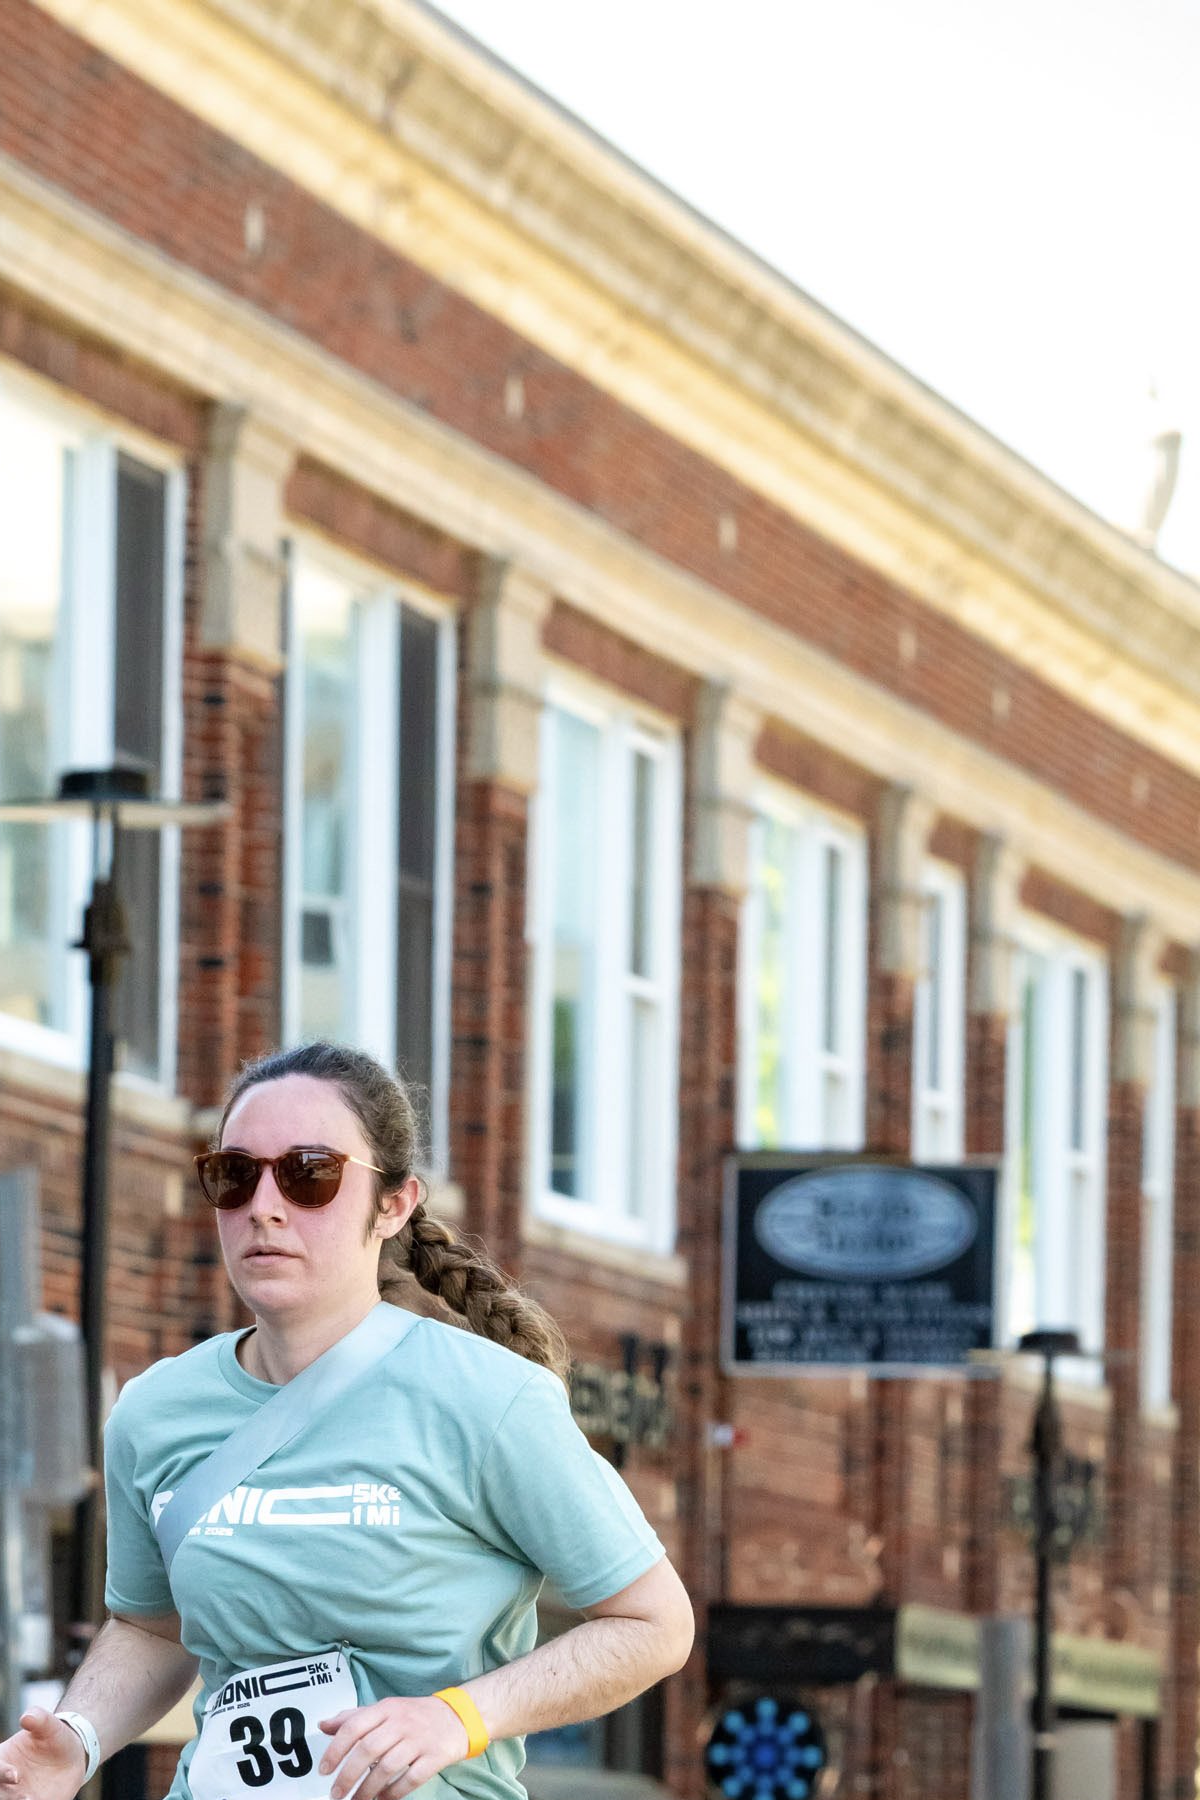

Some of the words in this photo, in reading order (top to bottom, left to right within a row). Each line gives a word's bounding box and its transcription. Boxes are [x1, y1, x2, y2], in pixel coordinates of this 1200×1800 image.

[151, 1485, 351, 1528] NIC
[307, 1662, 330, 1675] 5K&
[229, 1706, 313, 1787] 39
